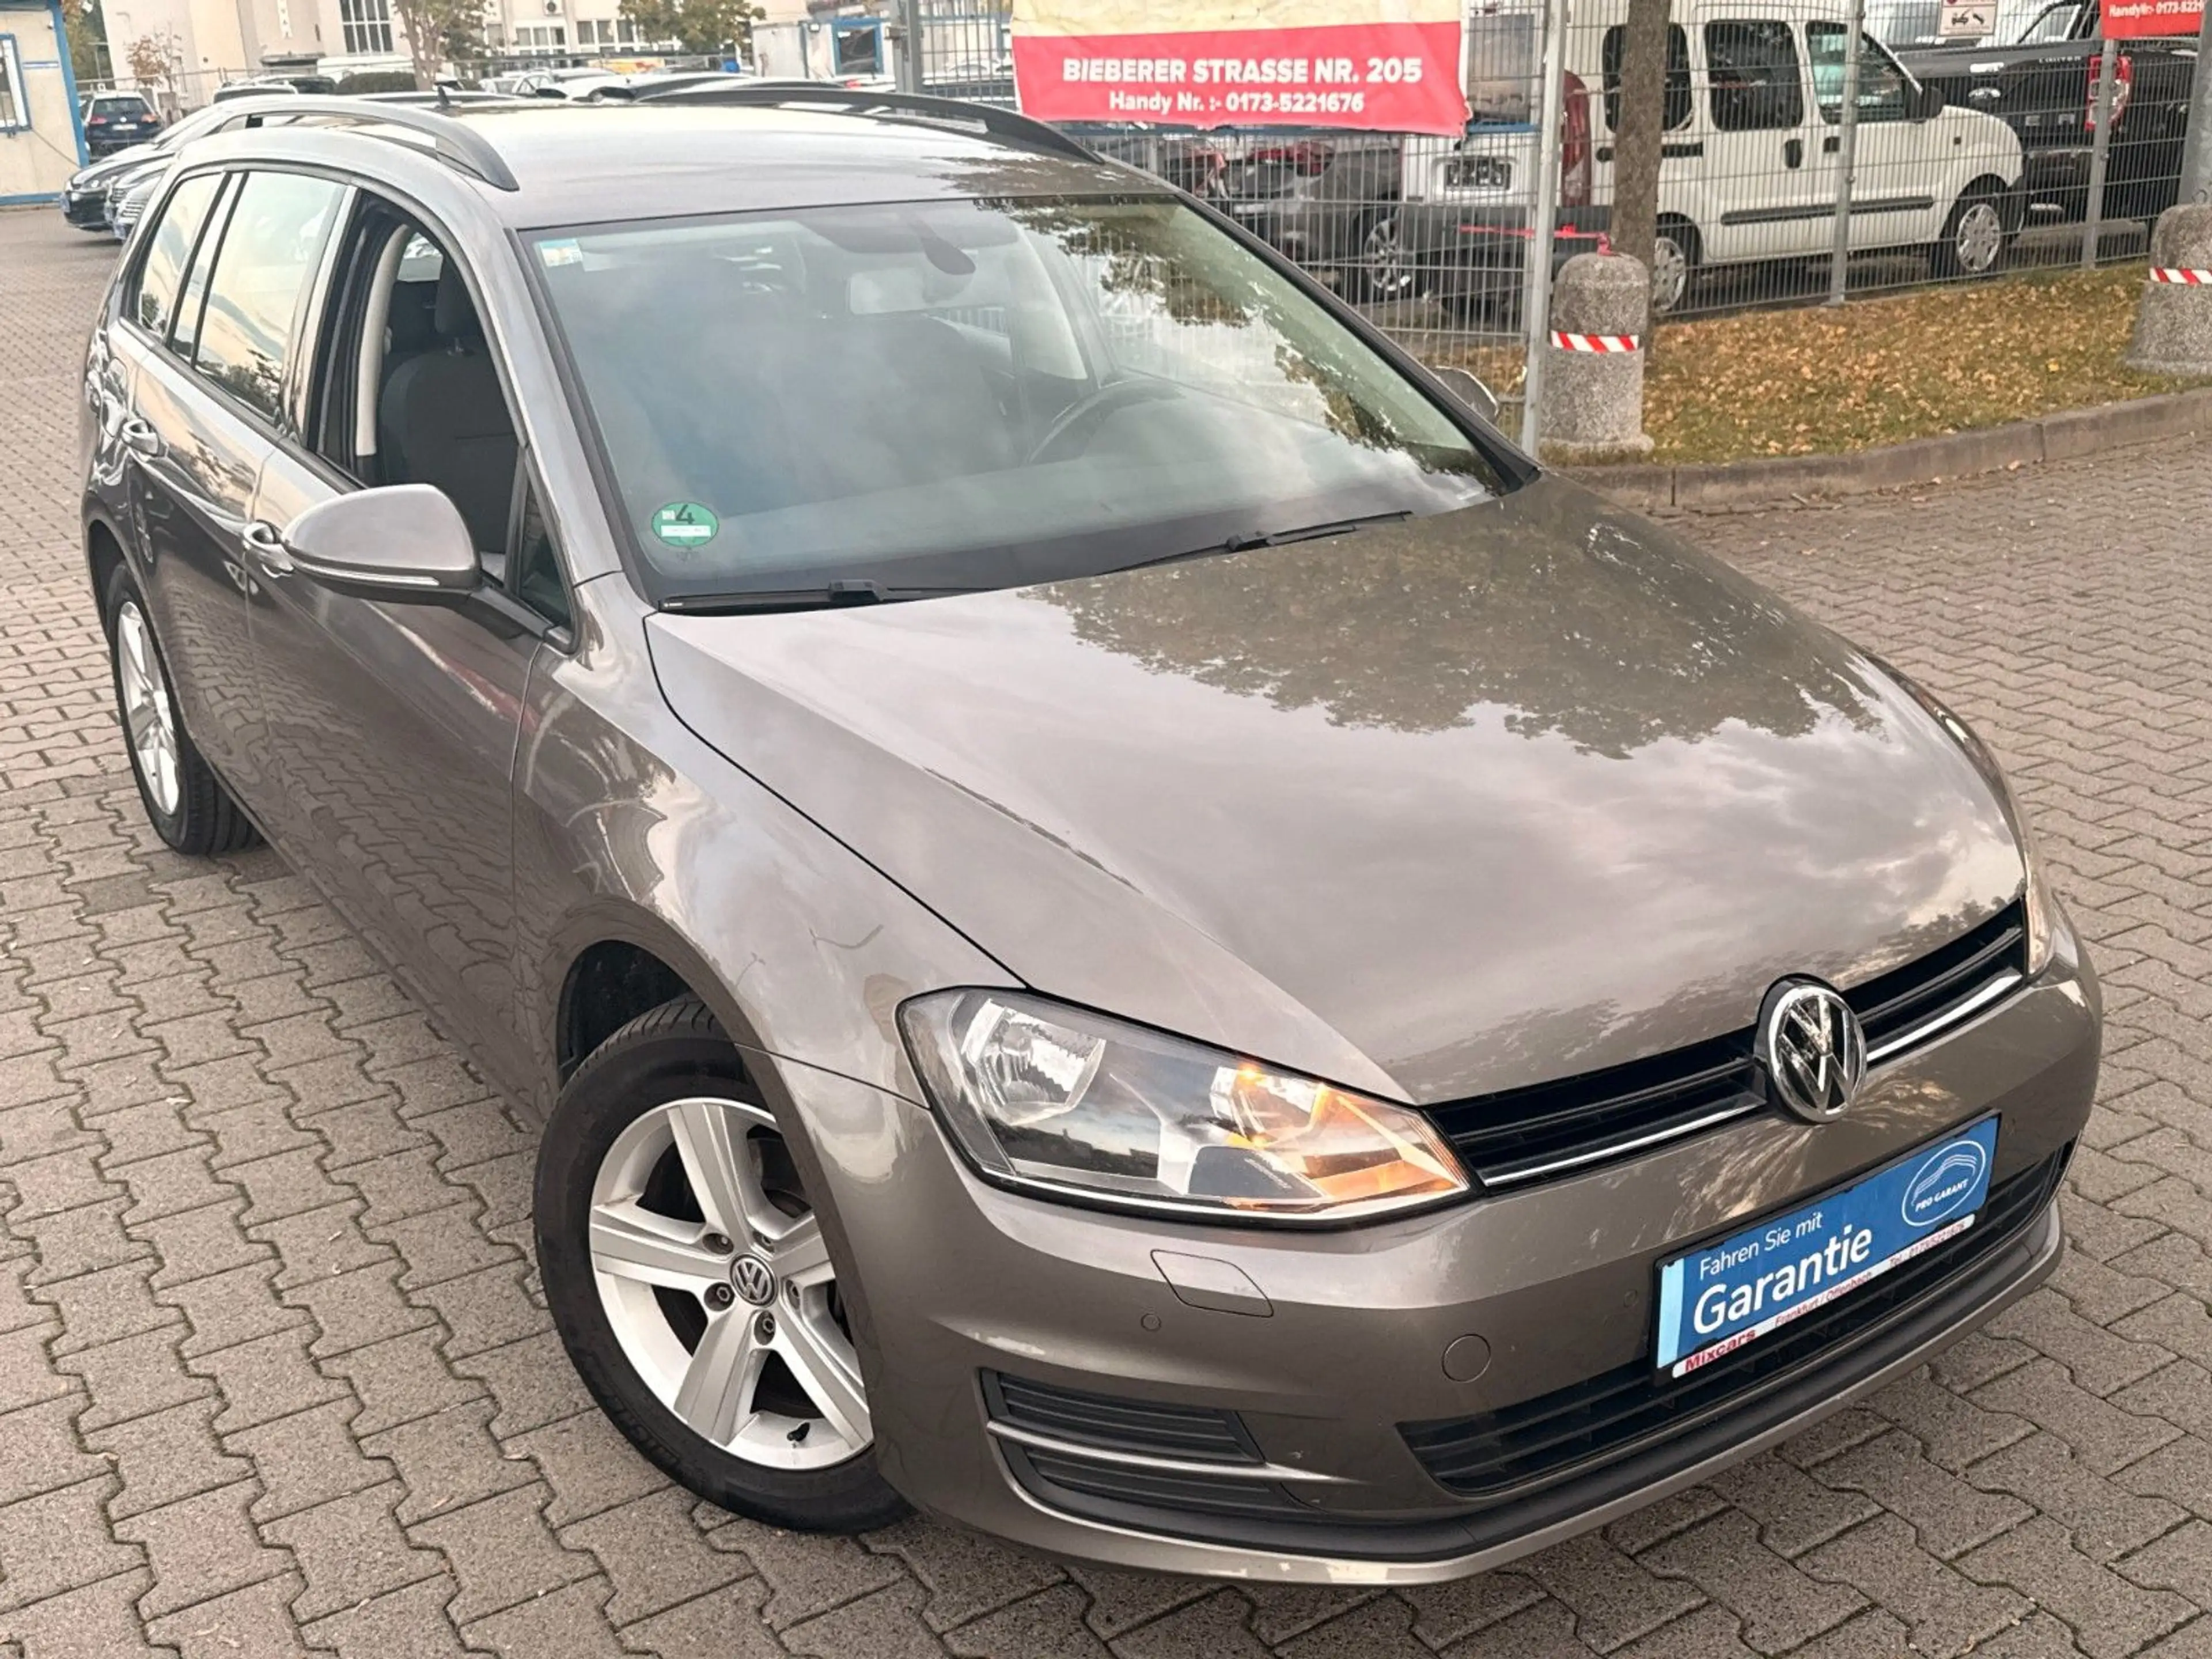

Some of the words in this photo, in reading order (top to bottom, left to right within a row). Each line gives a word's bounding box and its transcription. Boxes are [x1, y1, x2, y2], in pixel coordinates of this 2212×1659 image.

[1063, 58, 1187, 82] BIEBERER
[1193, 58, 1309, 83] STRASSE
[1315, 58, 1359, 83] NR.
[1366, 56, 1422, 83] 205
[1109, 90, 1172, 115] Handy
[1177, 91, 1205, 112] Nr.
[1226, 92, 1365, 112] 0173-5221676
[676, 505, 696, 524] 4
[1915, 1196, 1933, 1212] PRO
[1934, 1178, 1968, 1202] GARANT
[1700, 1242, 1759, 1281] Fahren
[1764, 1227, 1791, 1251] Sie
[1796, 1211, 1824, 1238] mit
[1694, 1225, 1872, 1334] Garantie
[1685, 1330, 1756, 1372] Mixcars
[1775, 1297, 1820, 1326] Frankfurt
